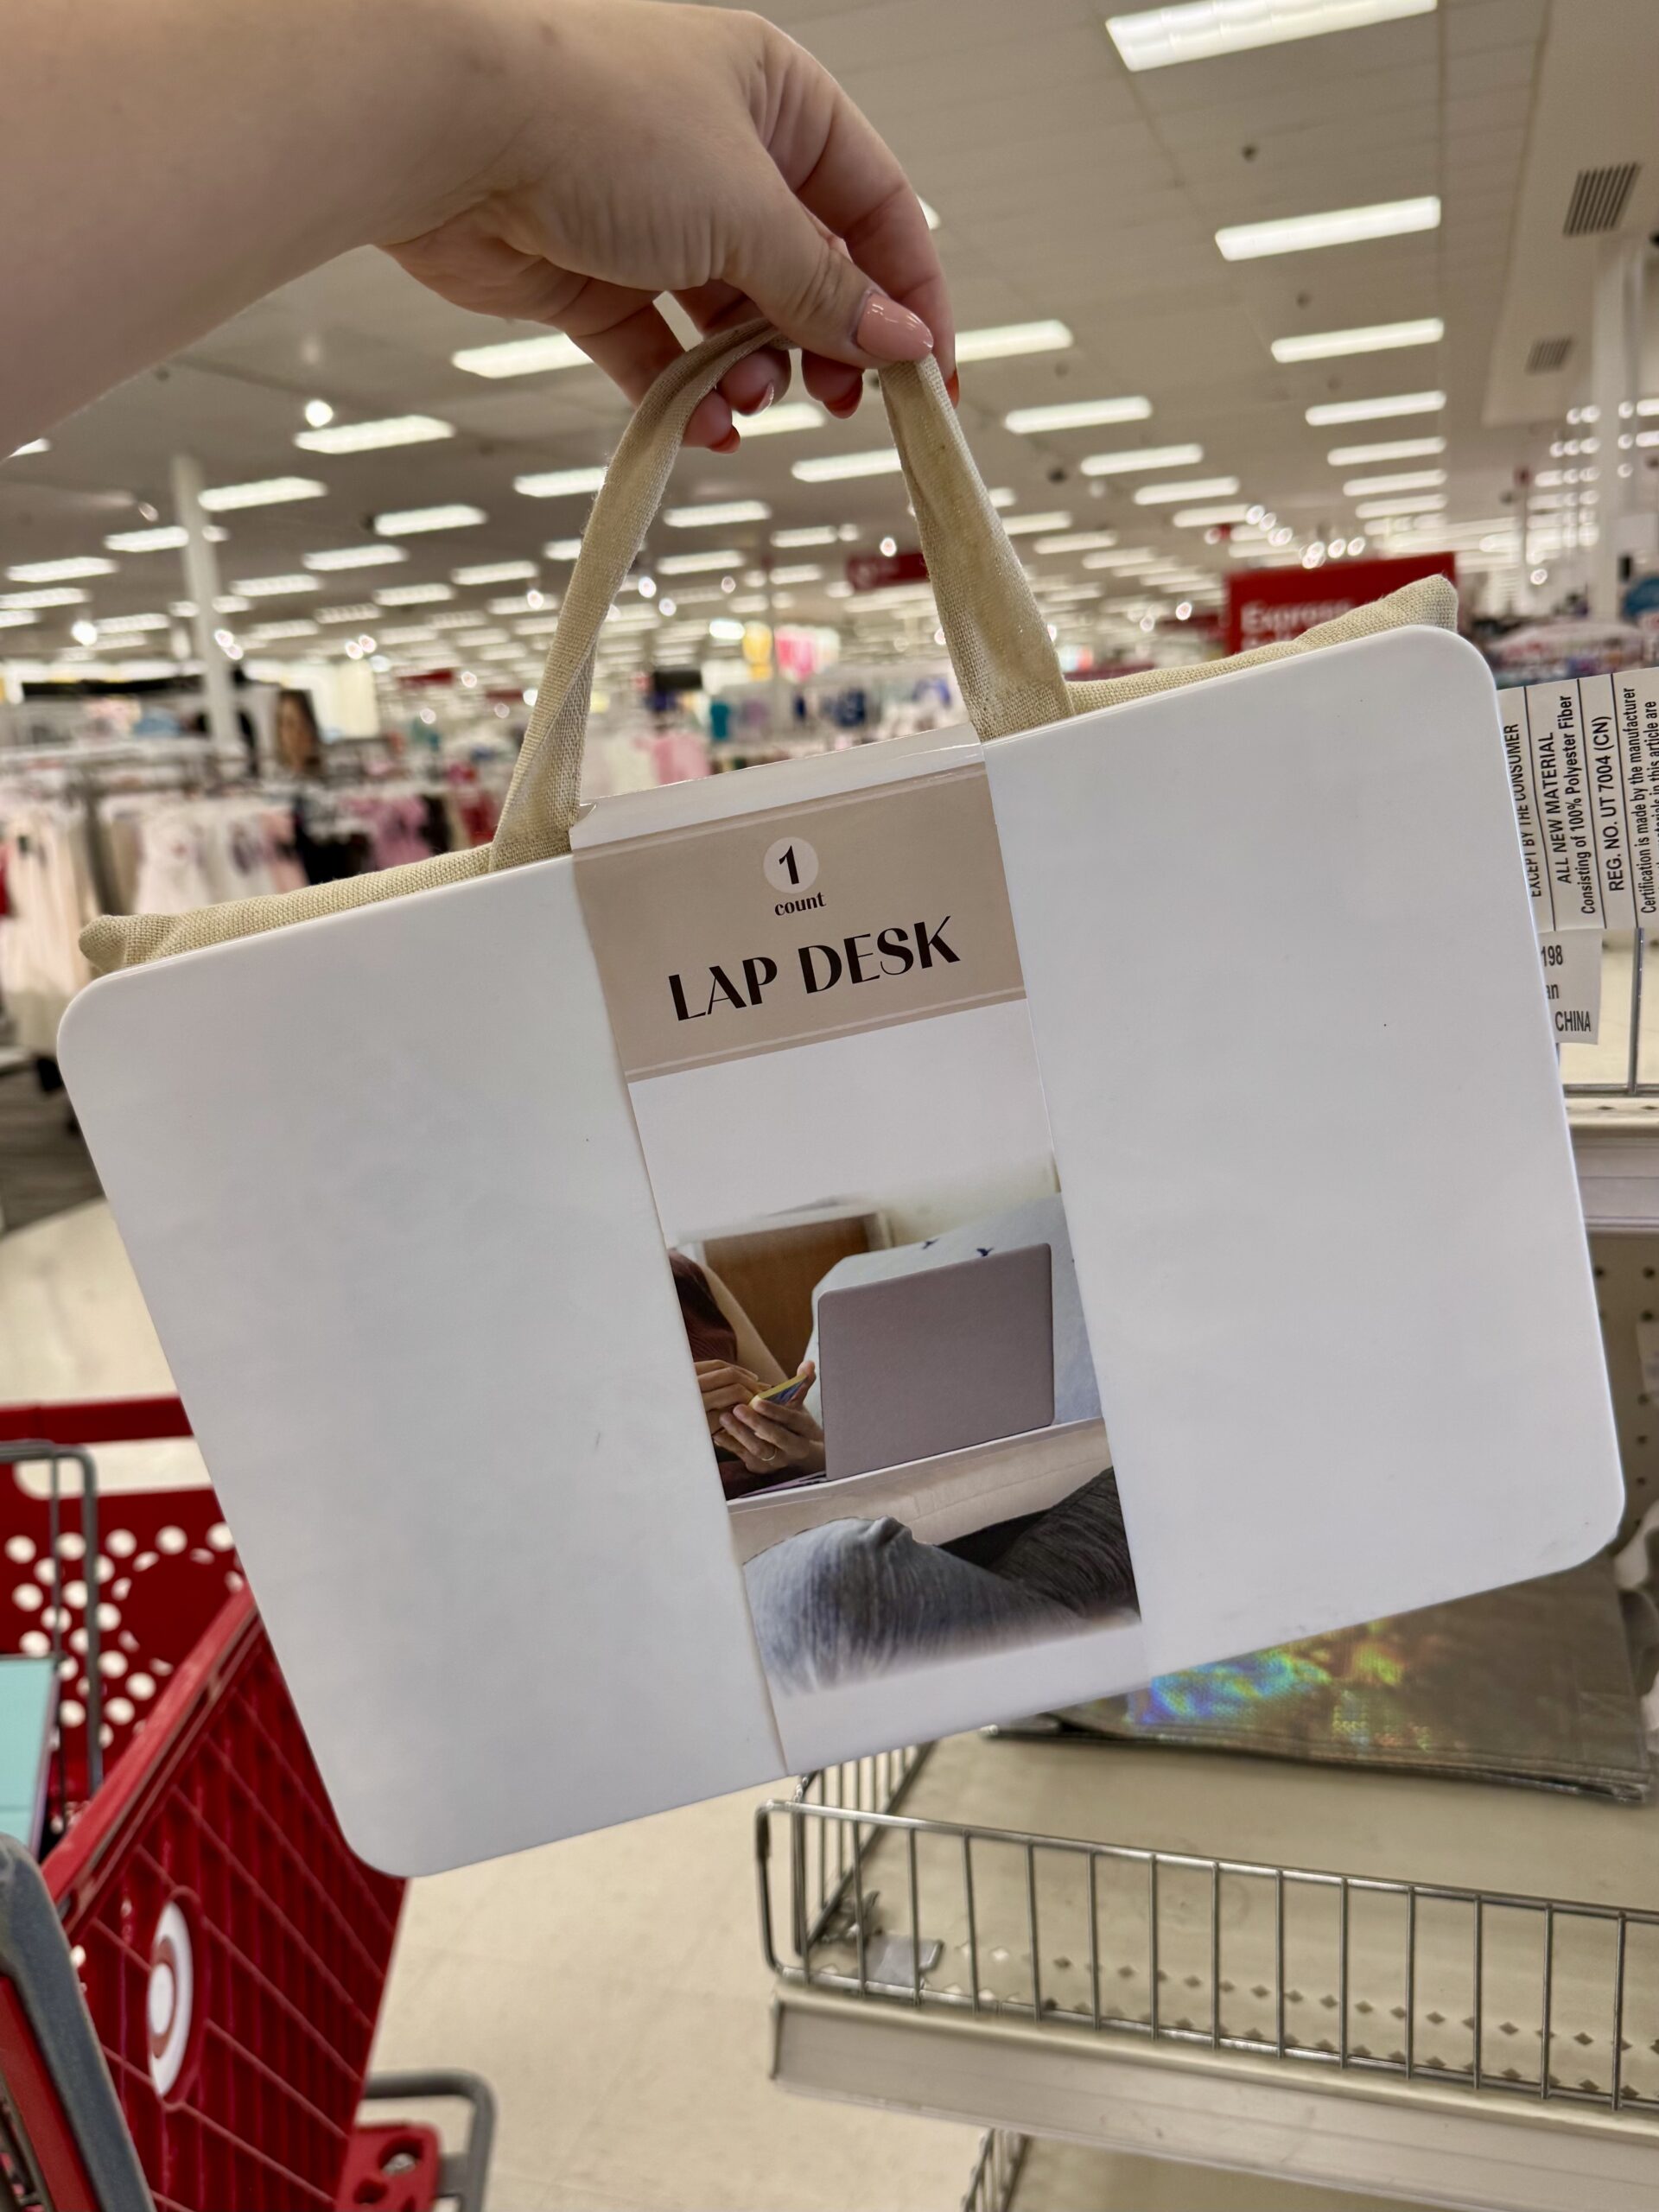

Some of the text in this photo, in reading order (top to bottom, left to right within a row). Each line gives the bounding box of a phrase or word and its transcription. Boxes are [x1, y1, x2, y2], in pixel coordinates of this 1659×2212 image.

[1622, 688, 1642, 763] manufacturer
[1644, 701, 1658, 719] are
[1643, 722, 1659, 758] article
[1503, 723, 1527, 801] CONSUMER
[1627, 766, 1644, 785] the
[1538, 732, 1572, 884] ALL NEW MATERIAL
[1557, 696, 1596, 914] Consisting of 100% Polyester Fiber
[1591, 716, 1625, 892] REG. NO. UT 7004 (CN)
[1630, 787, 1649, 802] by
[1630, 804, 1649, 835] made
[1634, 836, 1650, 847] is
[778, 844, 801, 885] 1
[1636, 849, 1657, 913] Certification
[774, 892, 827, 916] count
[668, 915, 961, 1021] LAP DESK
[1554, 1010, 1592, 1032] CHINA
